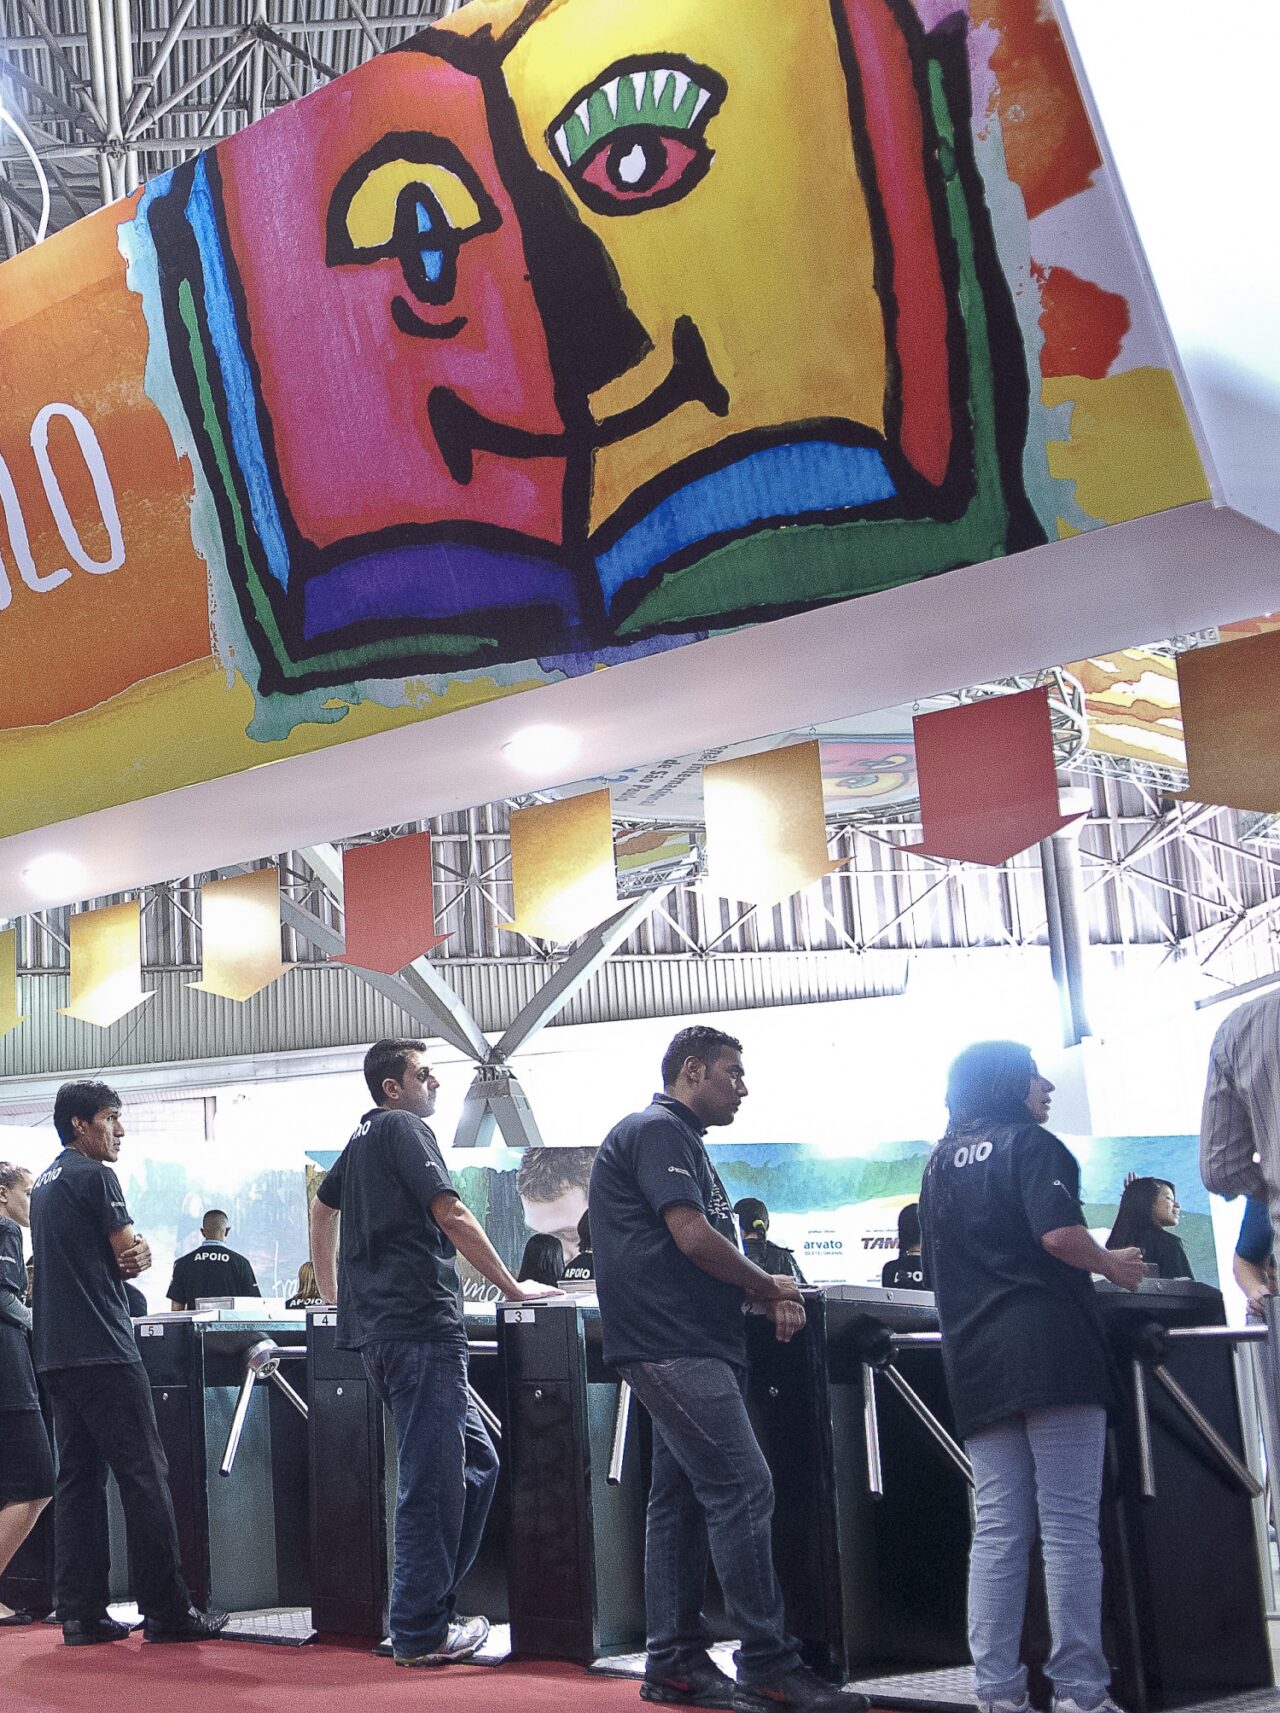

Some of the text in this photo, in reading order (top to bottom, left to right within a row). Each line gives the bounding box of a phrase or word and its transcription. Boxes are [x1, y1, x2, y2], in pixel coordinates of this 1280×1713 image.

[803, 1240, 843, 1250] arvato
[194, 1252, 230, 1263] APOIO
[565, 1267, 590, 1279] APOIO
[321, 1315, 329, 1325] 4
[514, 1311, 523, 1324] 3
[148, 1326, 155, 1337] 5
